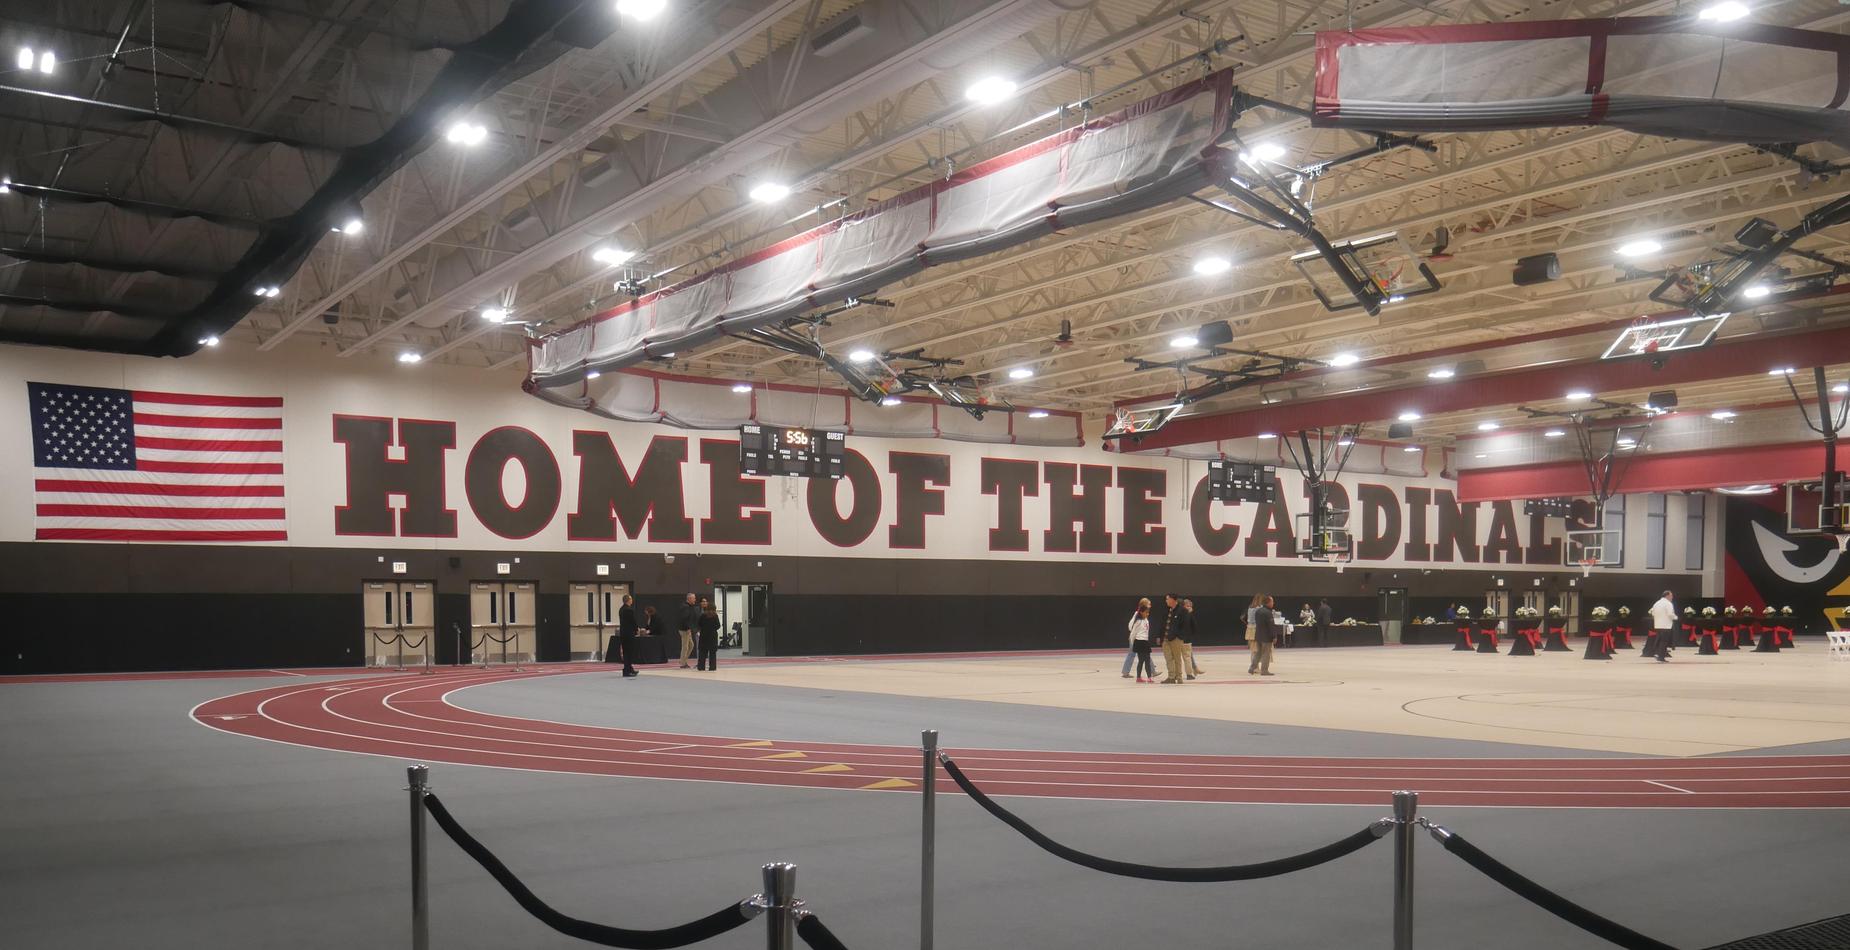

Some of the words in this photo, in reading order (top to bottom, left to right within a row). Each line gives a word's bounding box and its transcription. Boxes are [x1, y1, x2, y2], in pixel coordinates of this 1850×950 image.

[744, 426, 760, 434] HOME
[786, 430, 808, 444] 5:56
[826, 432, 844, 440] GUEST
[332, 413, 772, 545] HOME
[806, 447, 951, 549] OF
[980, 457, 1167, 555] THE
[1190, 474, 1597, 566] CARDINALS
